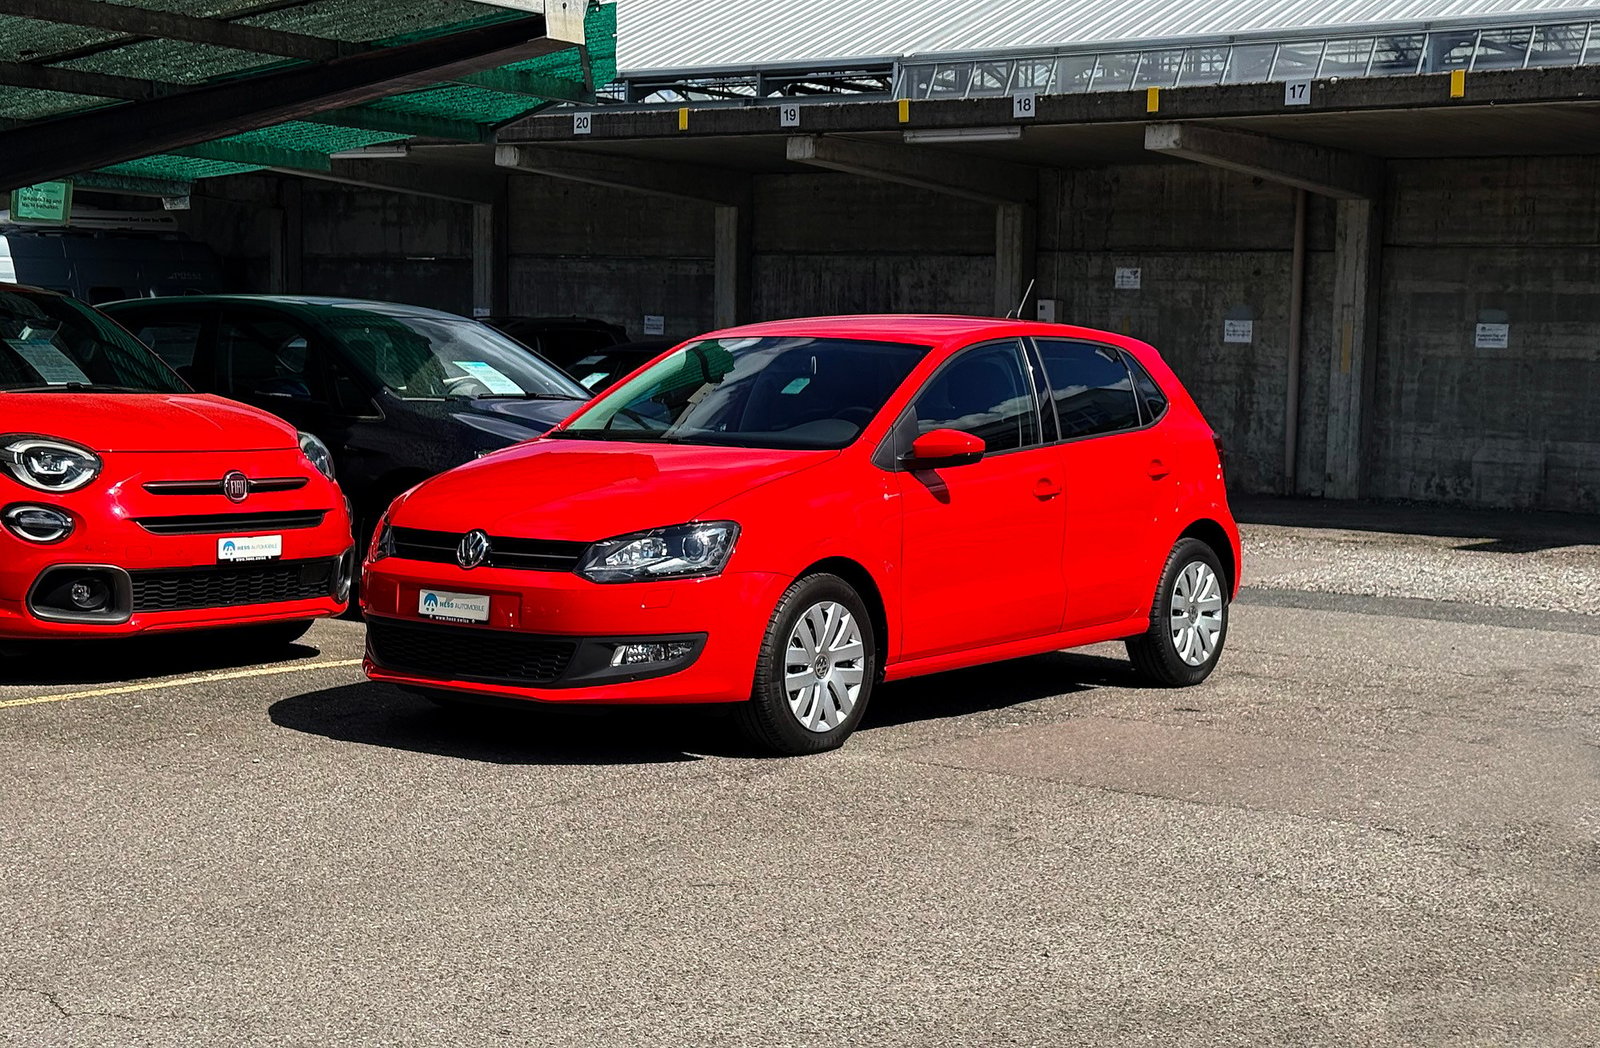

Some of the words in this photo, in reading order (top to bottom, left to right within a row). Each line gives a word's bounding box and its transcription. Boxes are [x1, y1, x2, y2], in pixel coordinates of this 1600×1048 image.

[1290, 84, 1306, 99] 17
[1016, 98, 1031, 111] 18
[783, 108, 796, 121] 19
[576, 117, 589, 129] 20
[230, 480, 244, 494] FIAT
[440, 601, 454, 609] HESS
[455, 603, 485, 612] AUTOMOBILE
